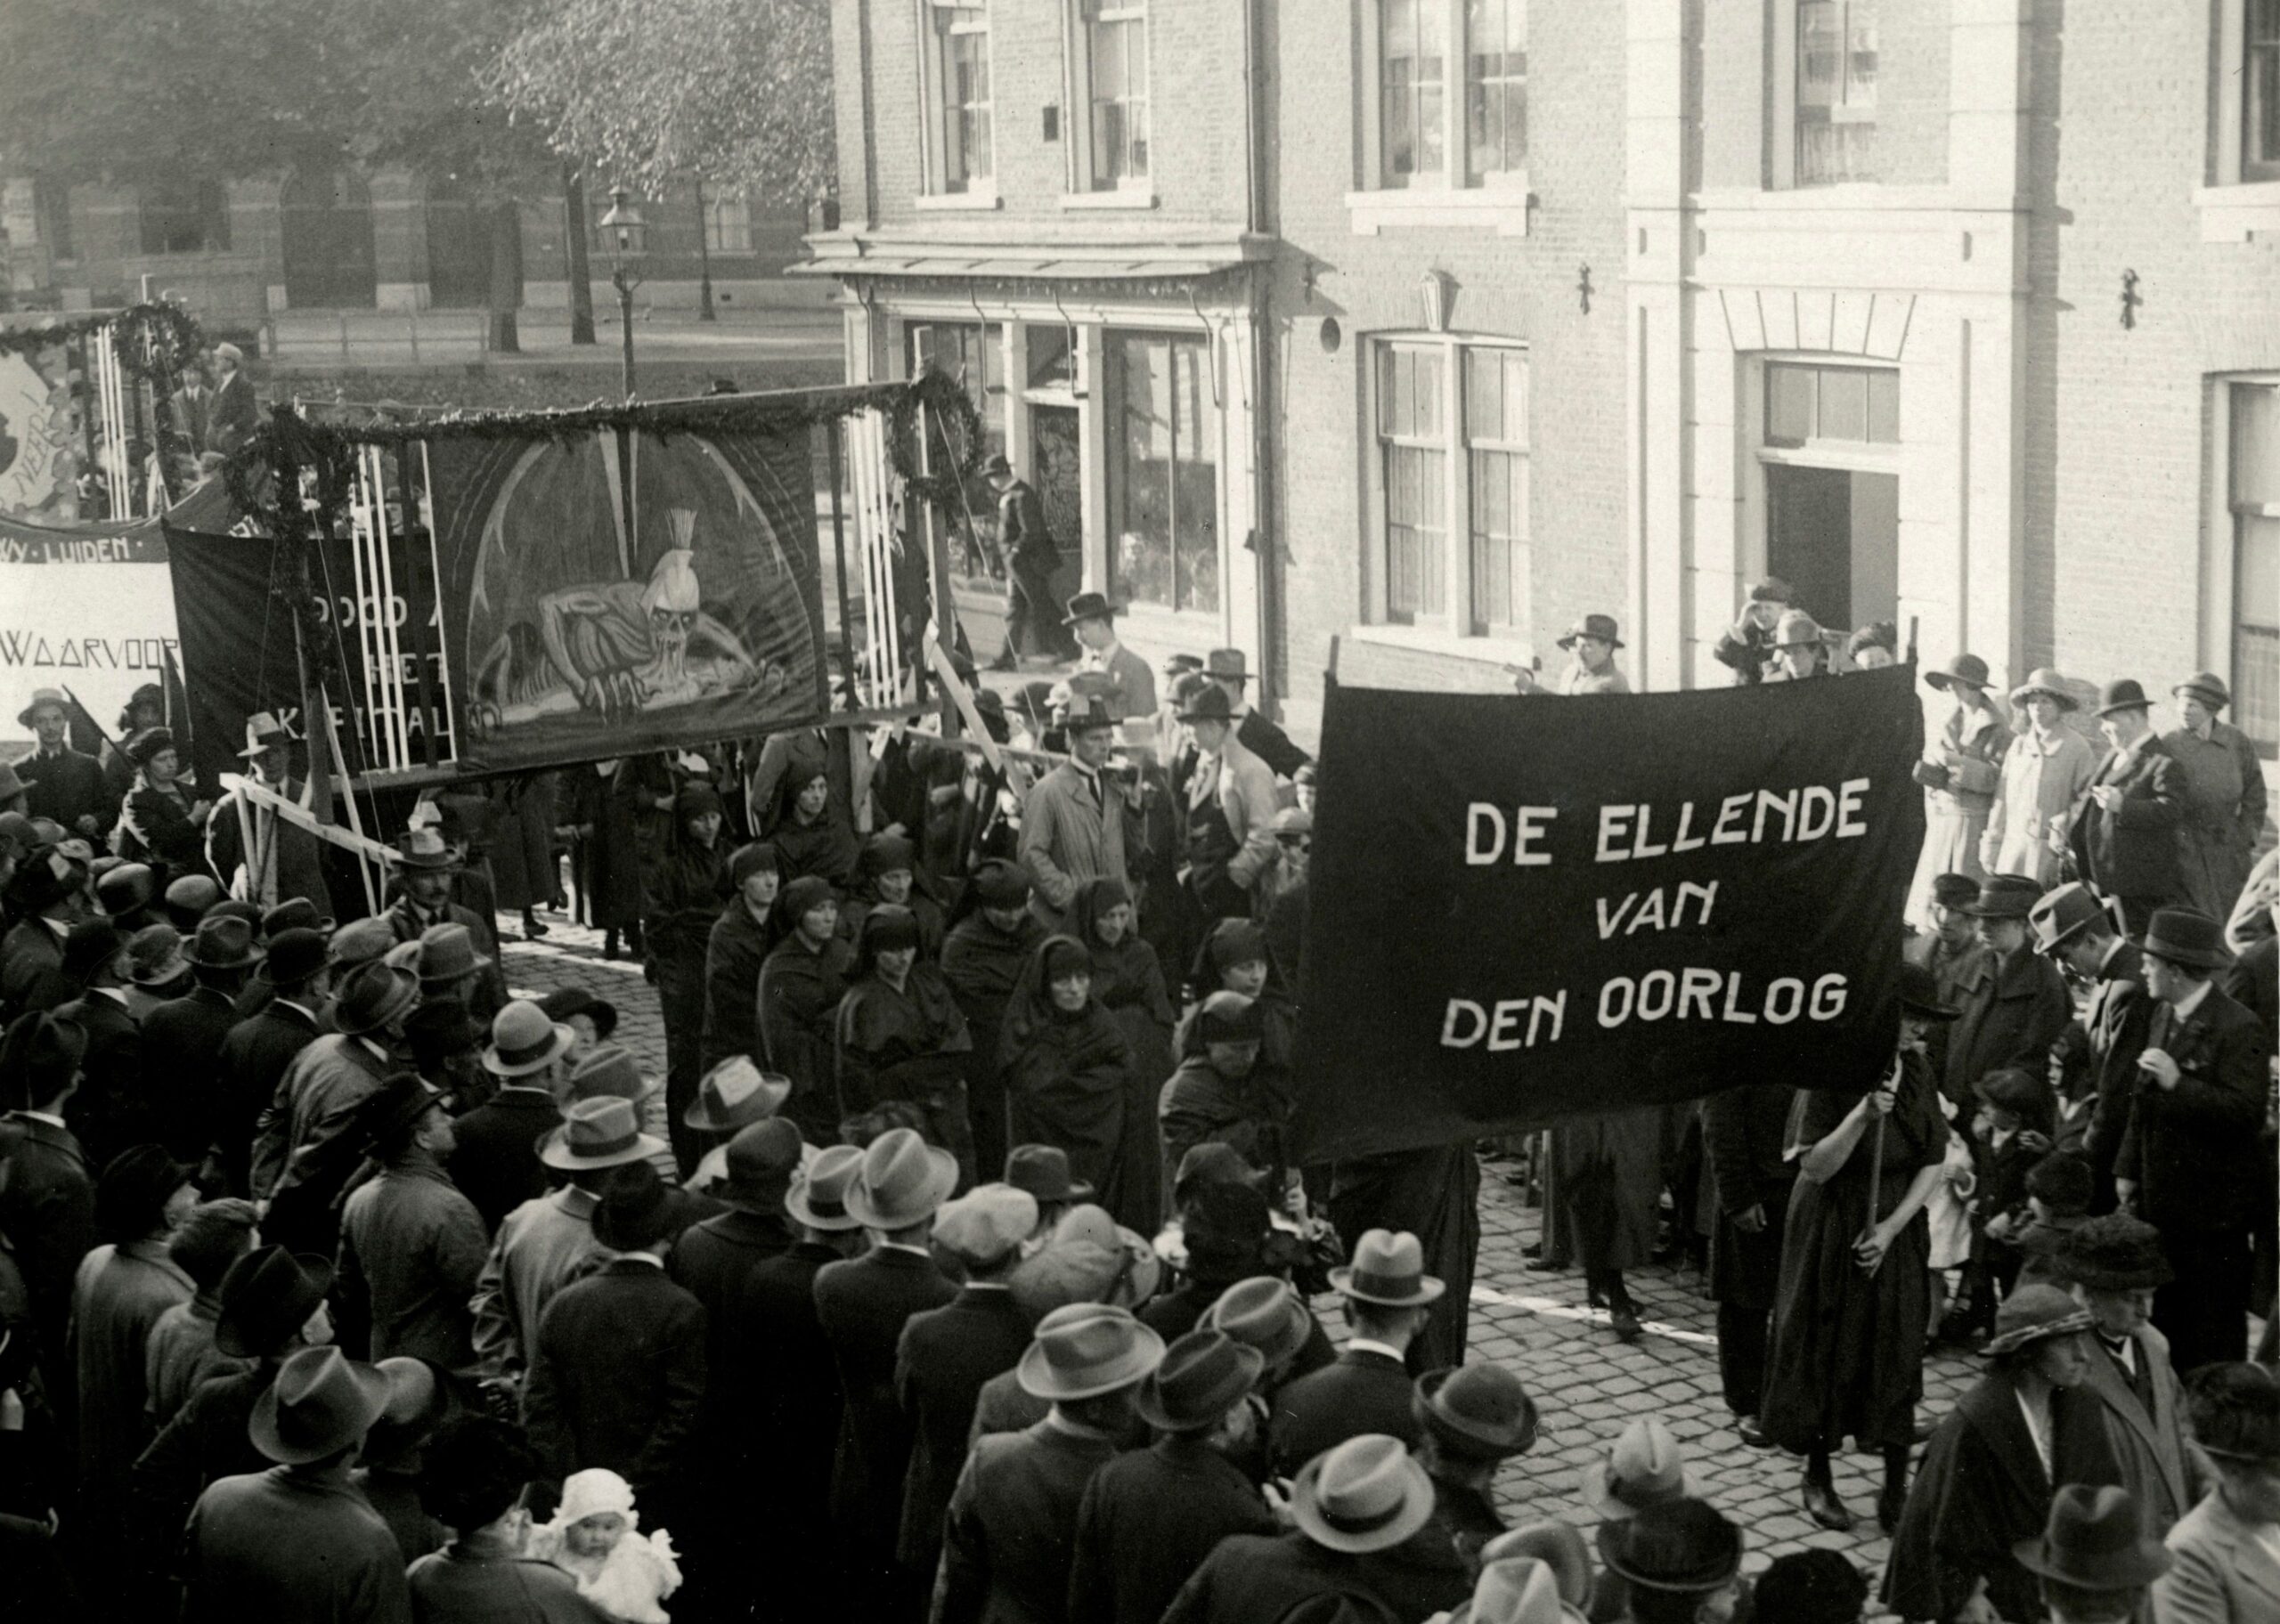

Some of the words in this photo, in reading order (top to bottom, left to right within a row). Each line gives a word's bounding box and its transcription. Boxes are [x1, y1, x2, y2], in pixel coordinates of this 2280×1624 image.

[45, 536, 131, 564] LUIDEN
[0, 630, 180, 669] WAARVOOR
[1465, 802, 1558, 865] DE
[1595, 777, 1870, 862] ELLENDE
[1597, 881, 1718, 939] VAN
[1440, 989, 1567, 1051] DEN
[1598, 967, 1848, 1028] OORLOG
